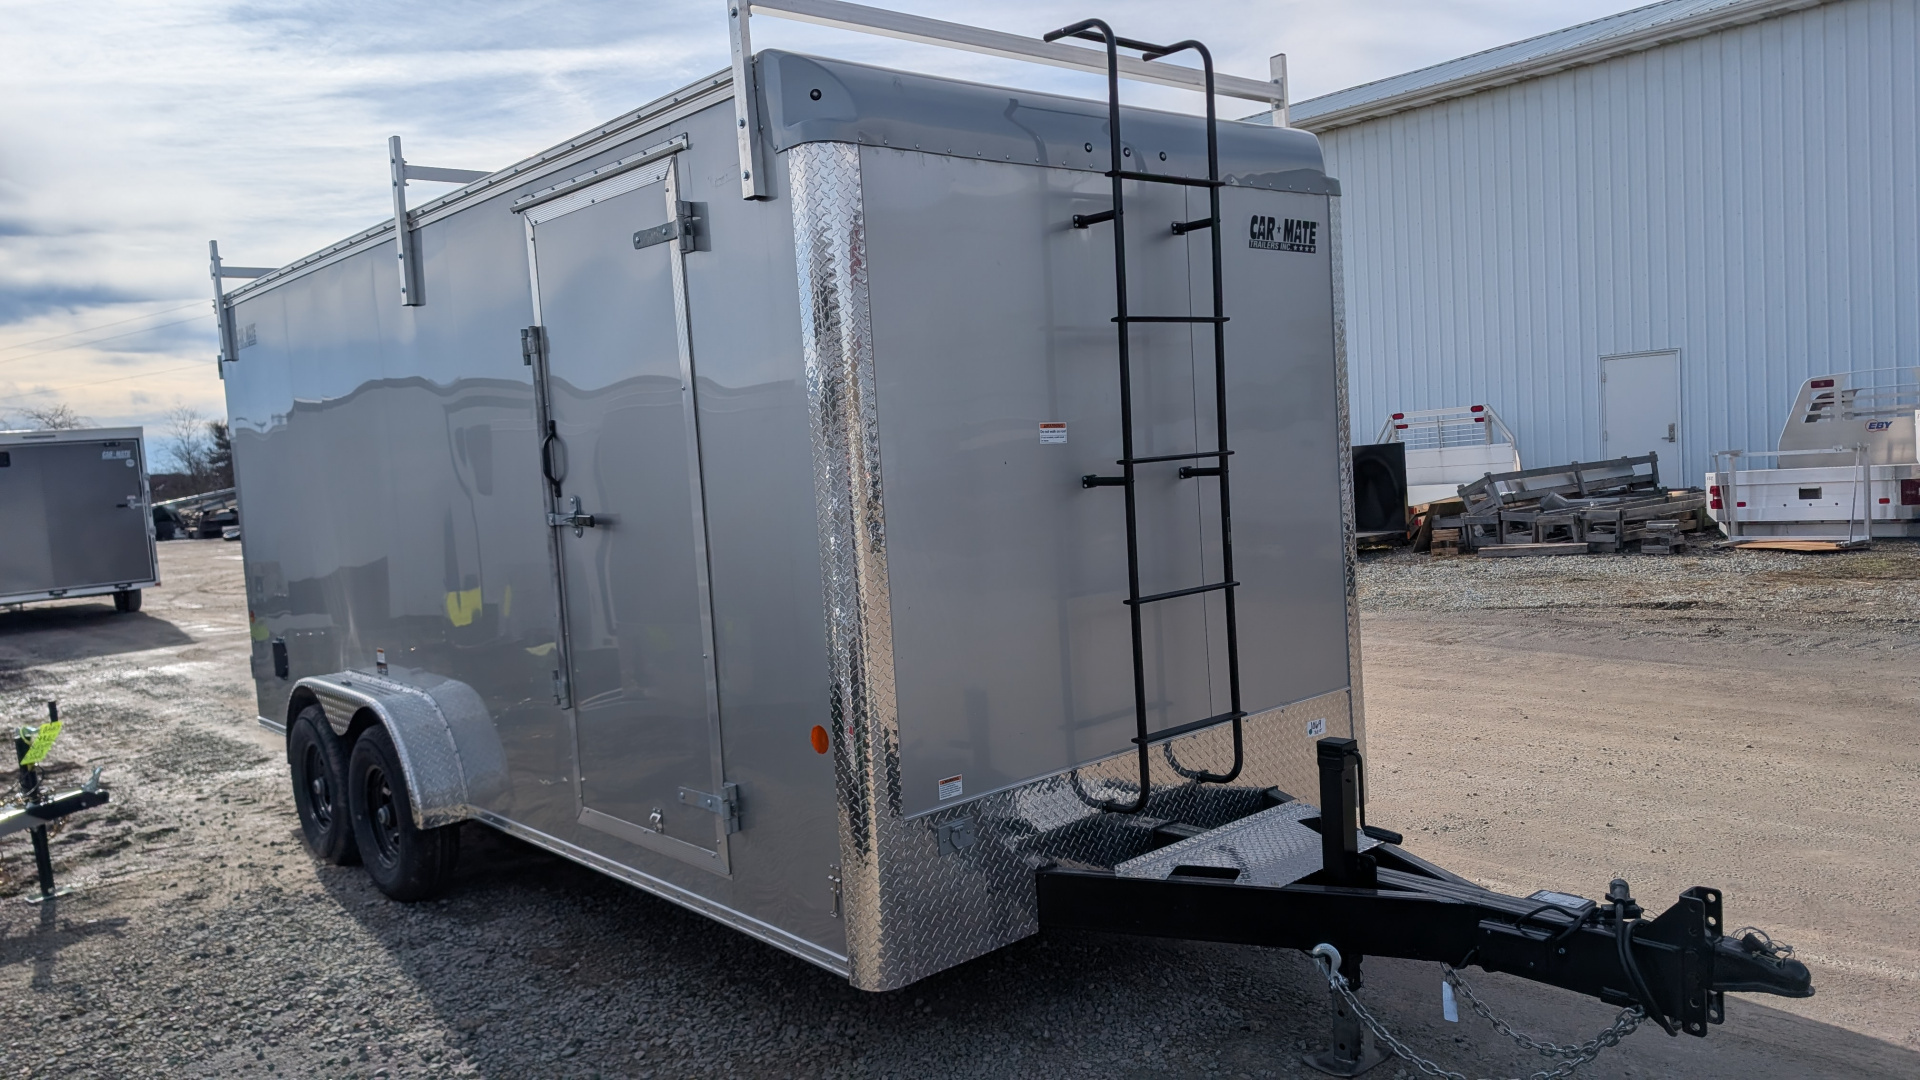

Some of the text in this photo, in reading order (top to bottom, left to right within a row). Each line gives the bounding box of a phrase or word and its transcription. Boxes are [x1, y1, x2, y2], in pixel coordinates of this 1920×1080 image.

[1249, 215, 1316, 244] CAR MATE
[1249, 240, 1292, 251] TRAILERS INC.
[1868, 421, 1893, 429] EBY
